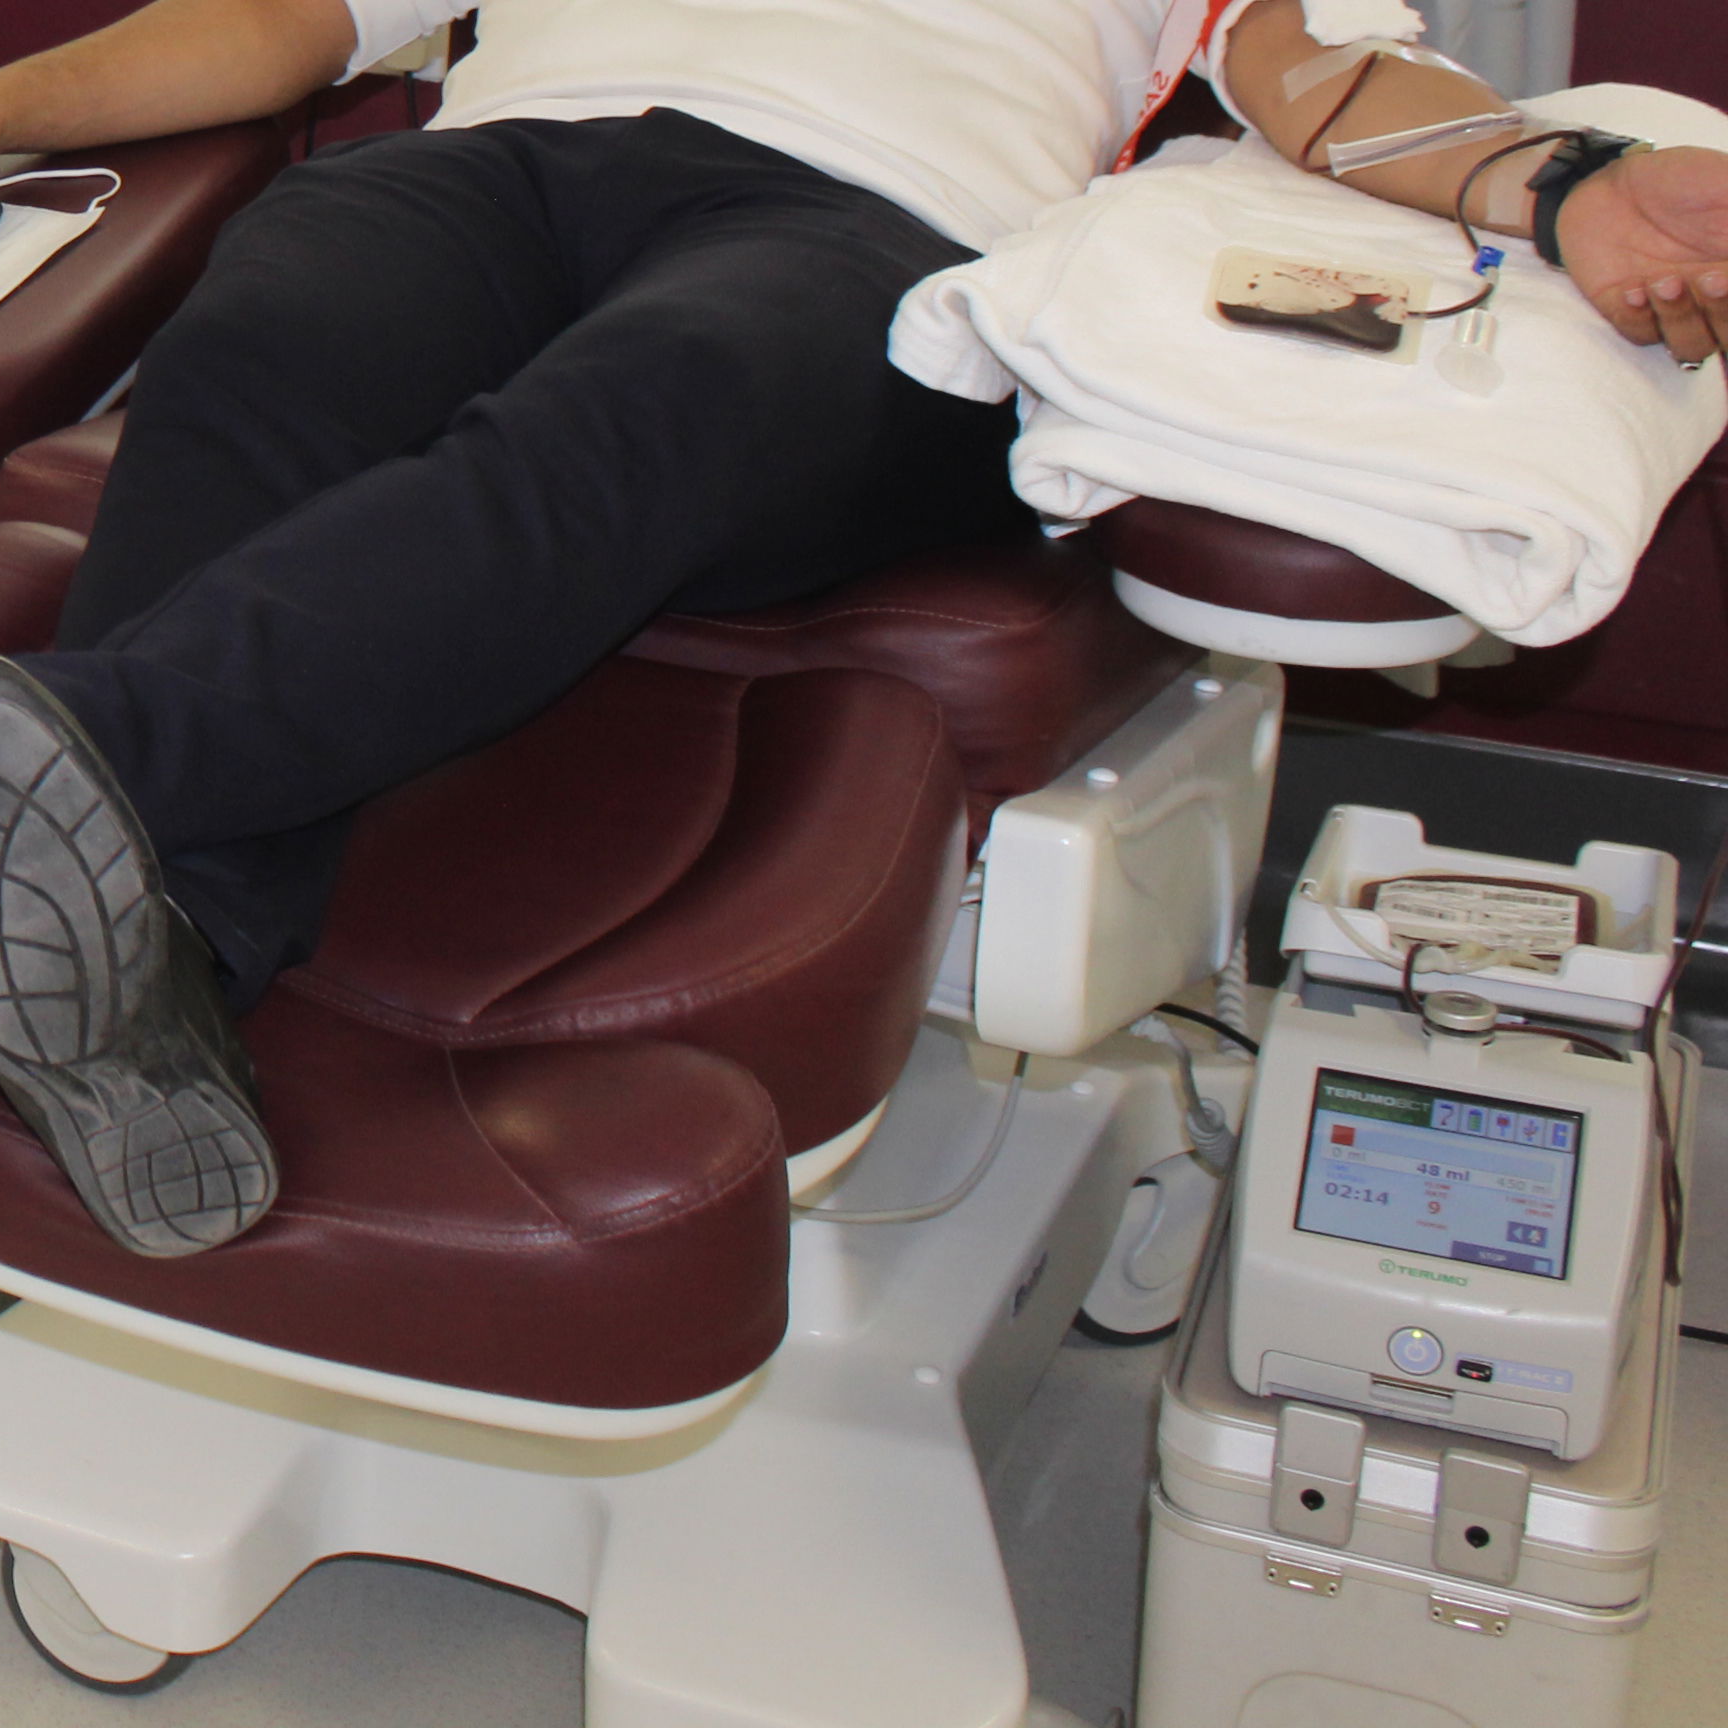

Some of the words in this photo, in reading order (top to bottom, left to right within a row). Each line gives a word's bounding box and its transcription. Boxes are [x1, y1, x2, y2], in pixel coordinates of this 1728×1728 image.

[1416, 1162, 1441, 1178] 48
[1445, 1166, 1470, 1183] ml
[1324, 1181, 1390, 1206] 02:14
[1427, 1200, 1441, 1216] 9
[1397, 1264, 1469, 1287] TERUMO
